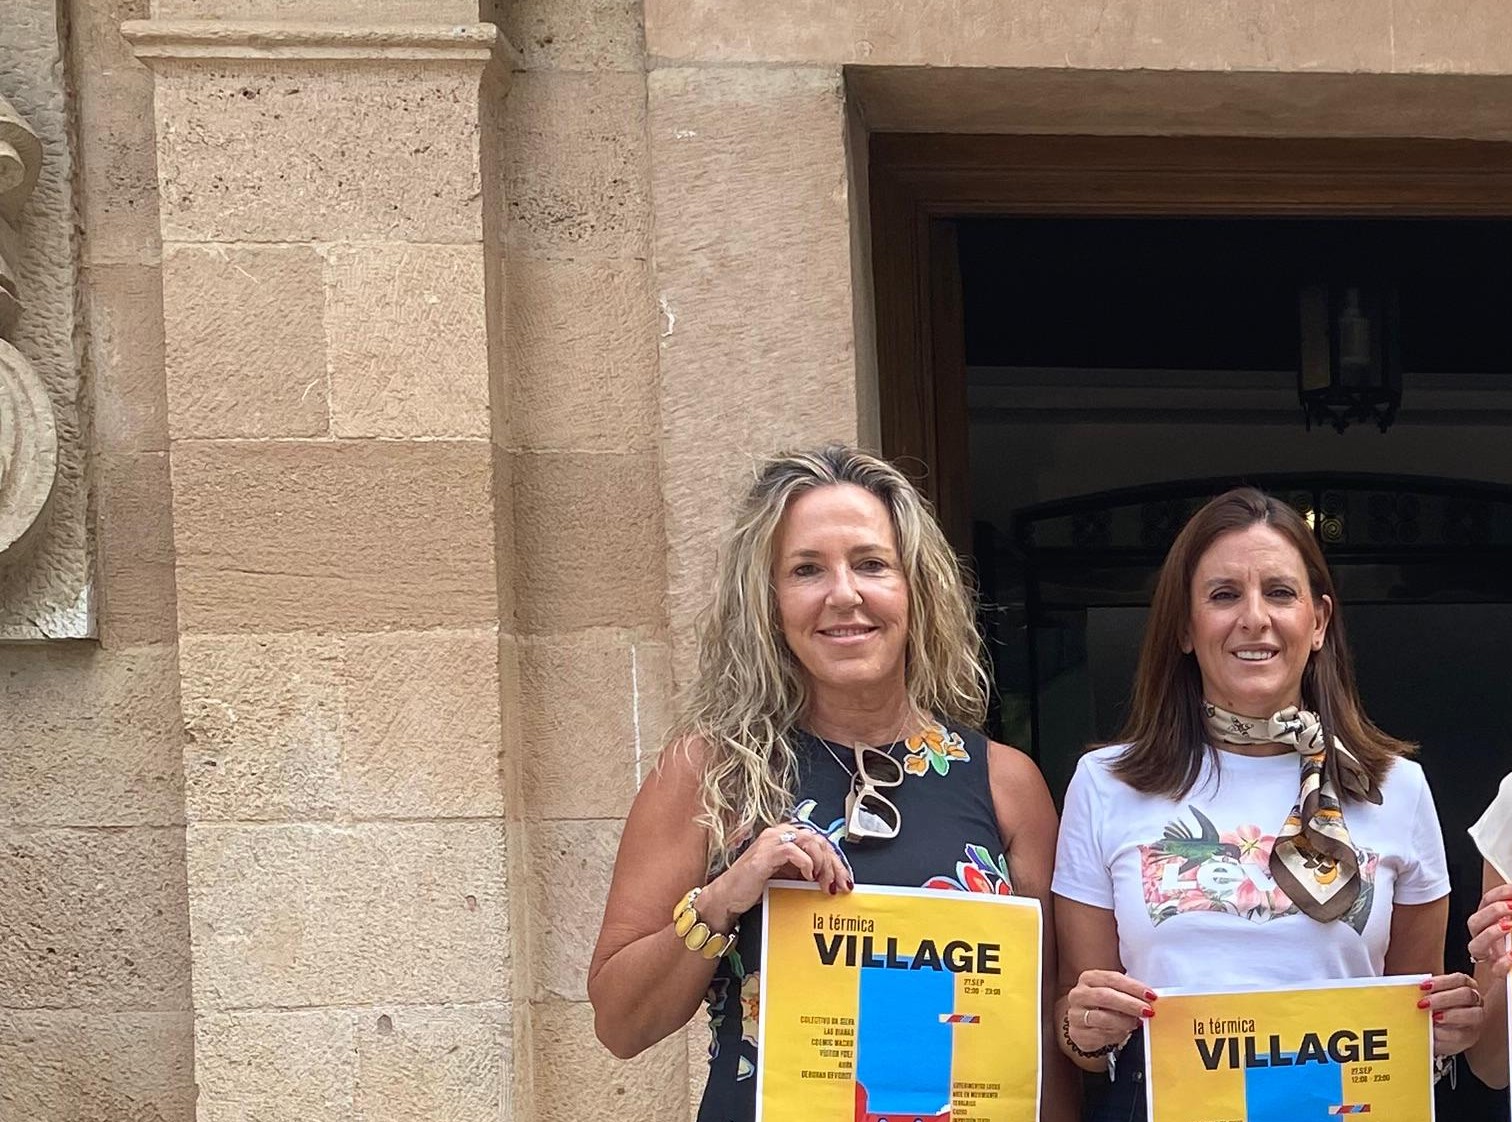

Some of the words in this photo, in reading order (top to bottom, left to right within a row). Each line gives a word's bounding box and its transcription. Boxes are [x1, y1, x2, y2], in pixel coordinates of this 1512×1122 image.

[813, 912, 824, 930] la
[829, 914, 875, 932] térmica
[813, 932, 1001, 975] VILLAGE
[1193, 1018, 1204, 1035] la
[1209, 1016, 1255, 1034] térmica
[1194, 1028, 1390, 1071] VILLAGE
